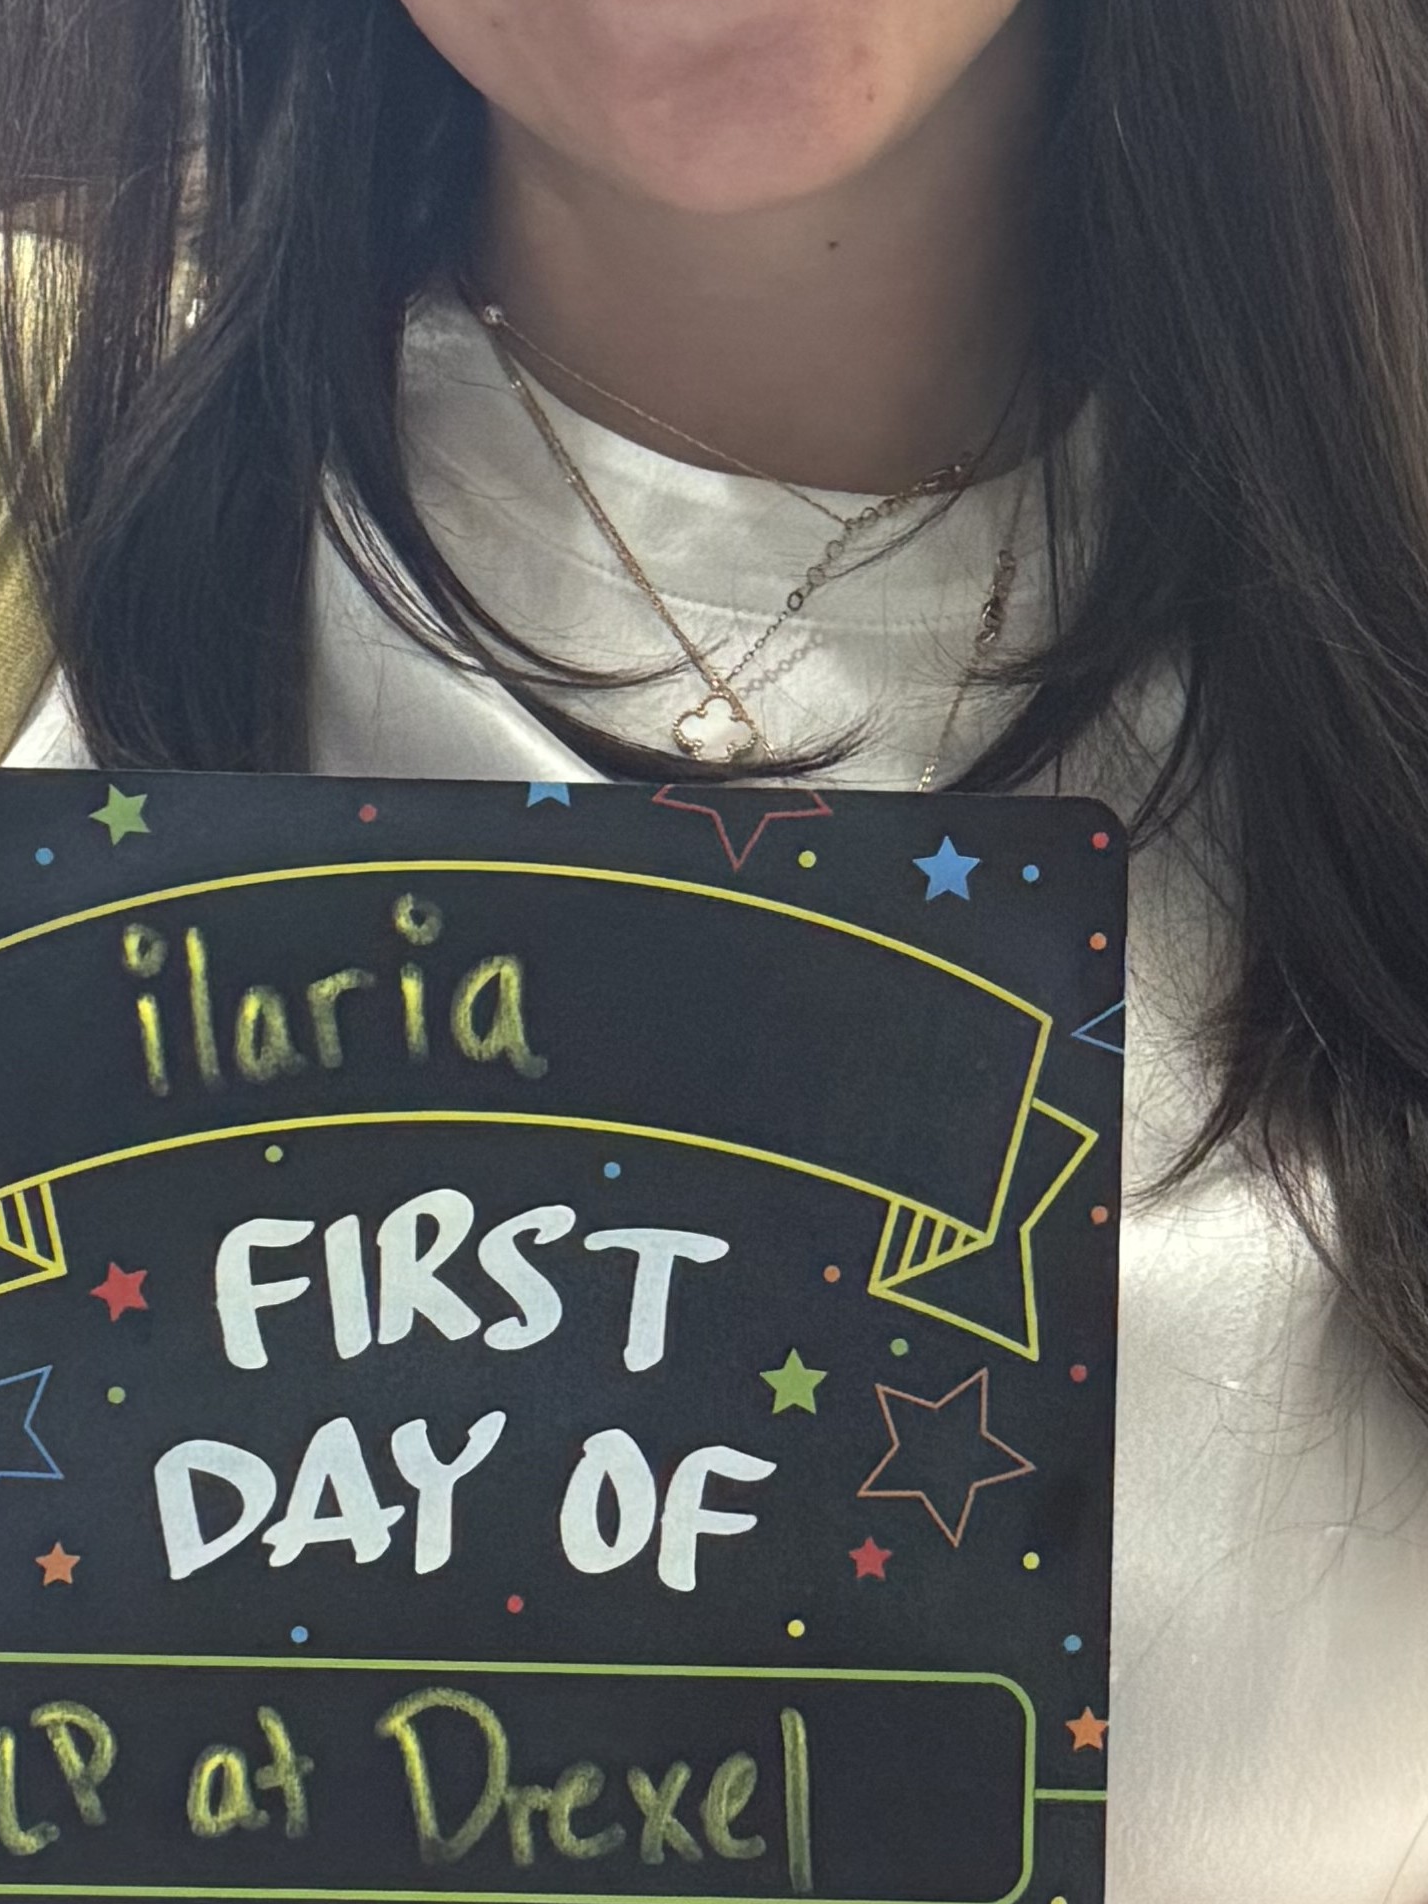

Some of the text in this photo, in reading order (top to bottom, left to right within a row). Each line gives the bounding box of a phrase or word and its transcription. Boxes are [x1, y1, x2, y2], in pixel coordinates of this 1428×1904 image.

[120, 894, 549, 1096] ilaria
[214, 1187, 731, 1373] FIRST
[153, 1409, 778, 1593] DAY OF
[185, 1705, 314, 1840] at
[374, 1687, 815, 1894] Drexel
